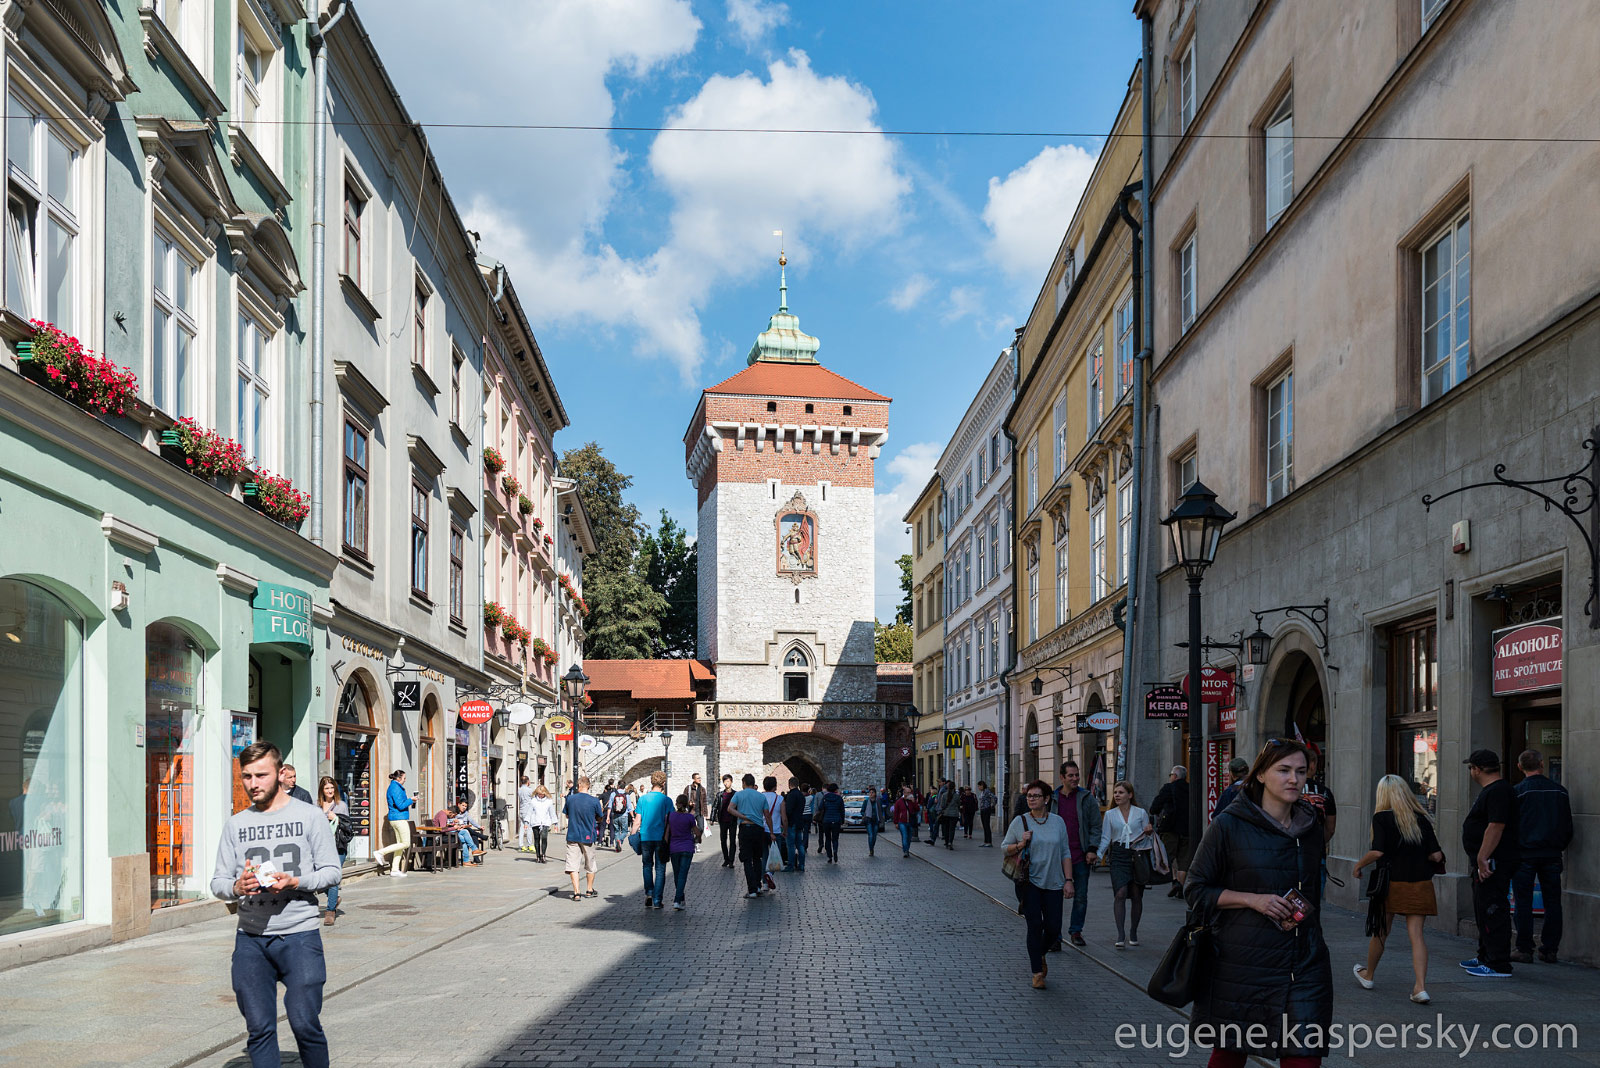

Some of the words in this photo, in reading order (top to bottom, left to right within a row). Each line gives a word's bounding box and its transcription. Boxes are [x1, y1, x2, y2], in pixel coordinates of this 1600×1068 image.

[1498, 634, 1559, 659] ALKOHOLE
[1495, 669, 1512, 681] ART.
[1513, 660, 1563, 678] SPOŻYWCZE
[1149, 702, 1188, 710] KEBAB
